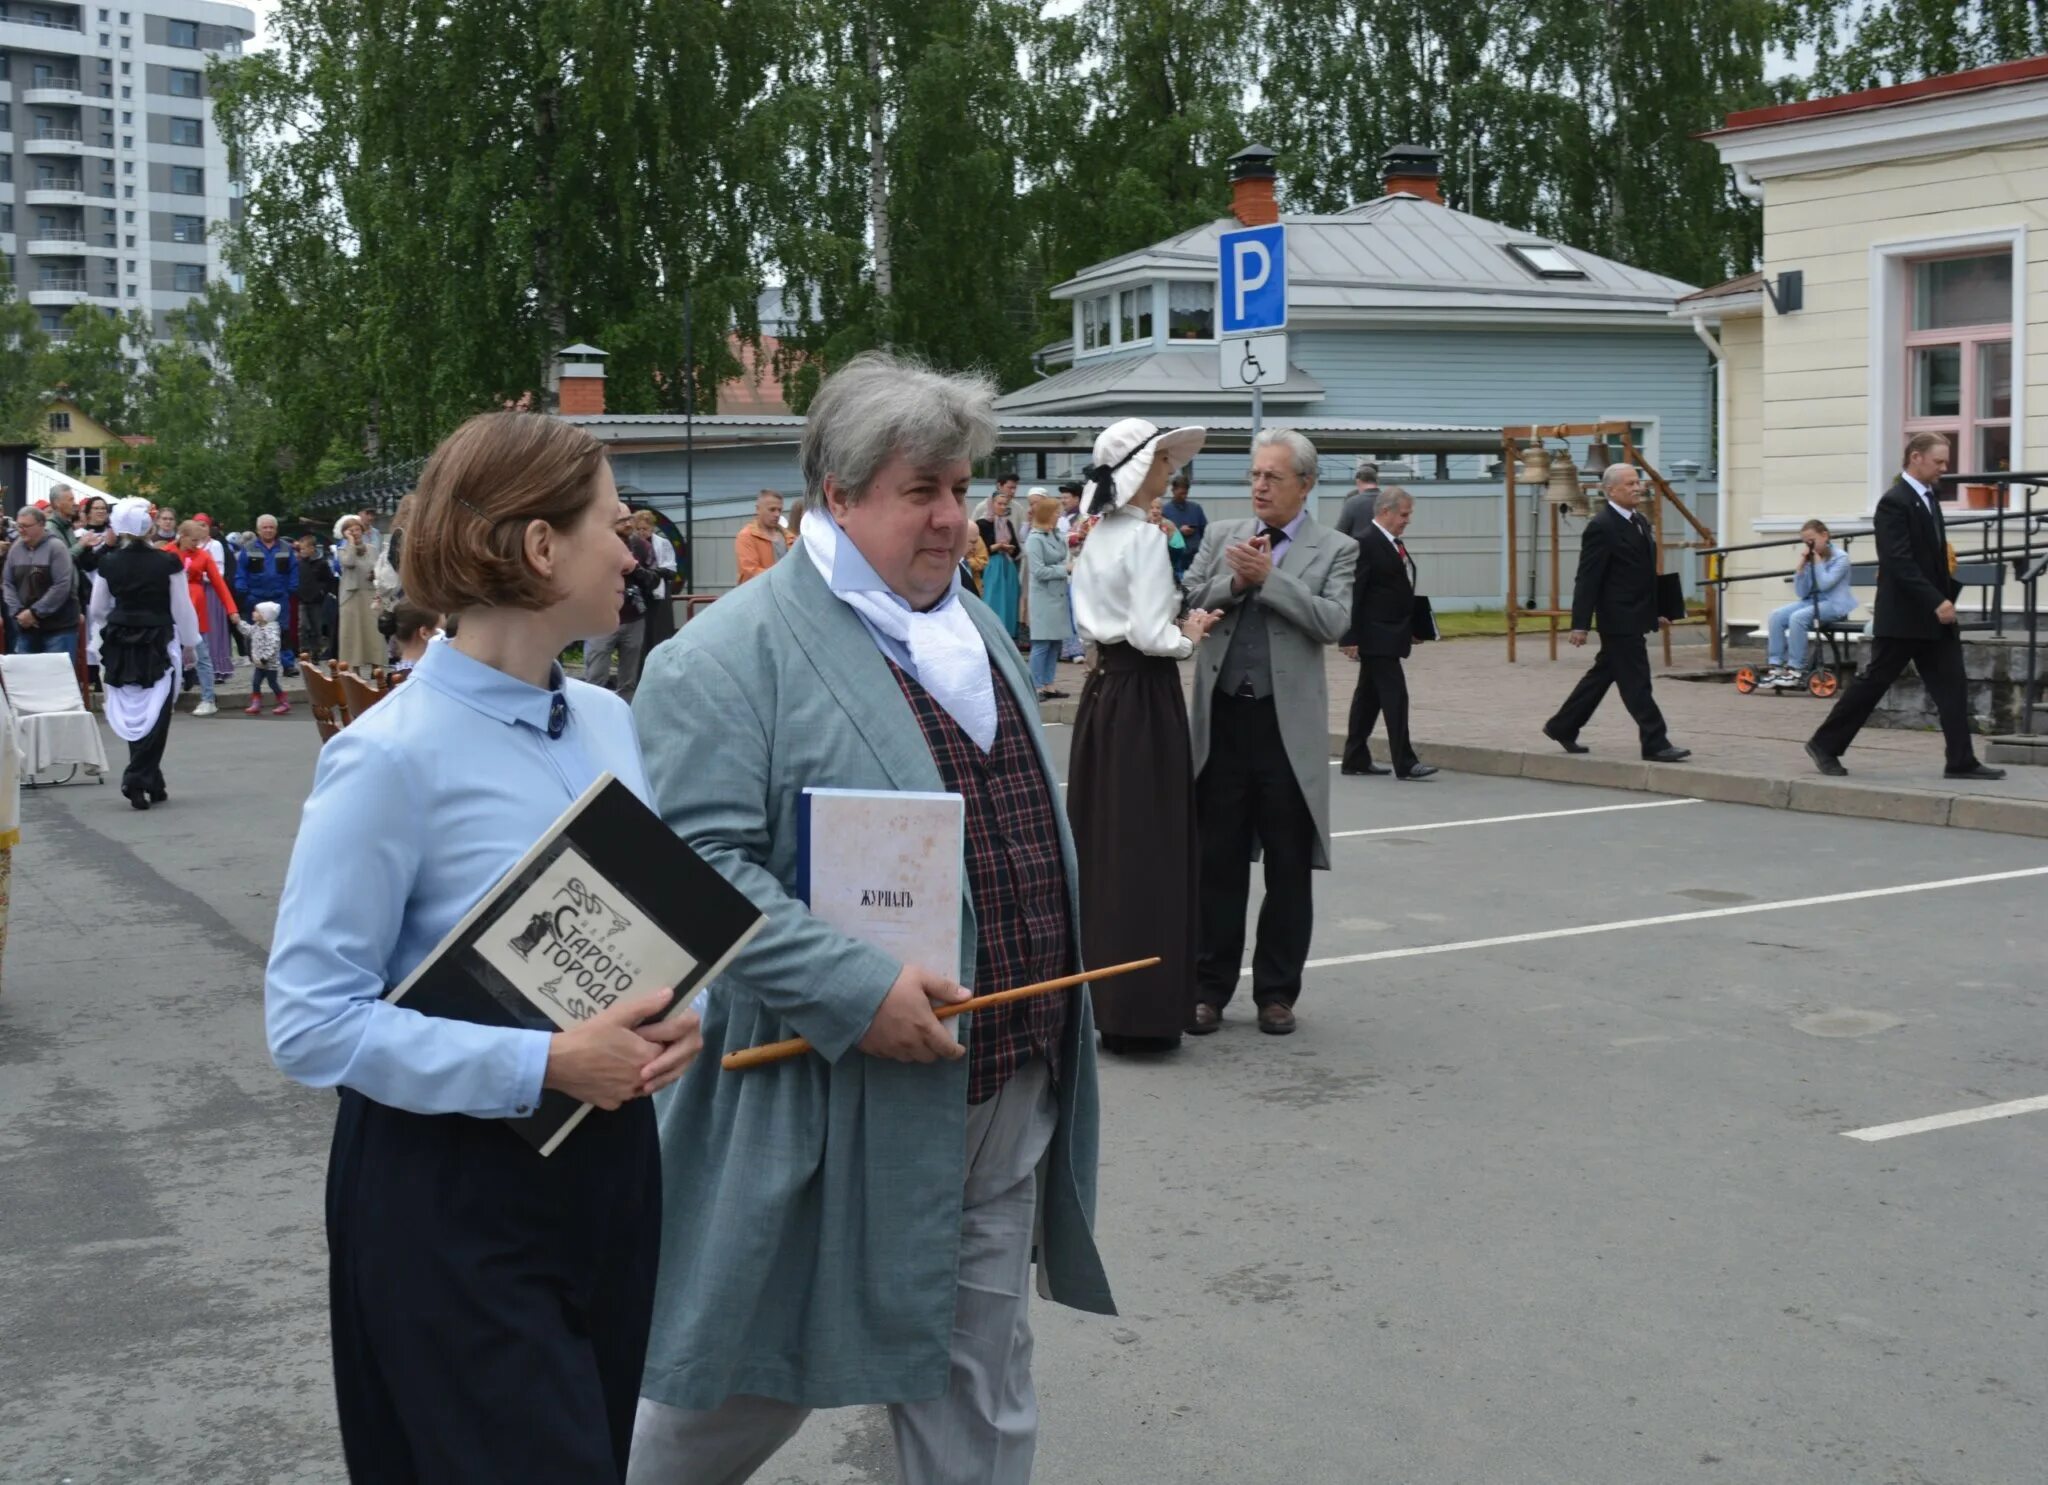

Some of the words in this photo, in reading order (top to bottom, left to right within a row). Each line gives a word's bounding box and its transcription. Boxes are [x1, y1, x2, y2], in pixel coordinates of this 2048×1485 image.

[1233, 240, 1272, 320] P
[861, 889, 913, 908] ЖУРНАЛЪ
[542, 940, 619, 1009] ГОРОДА
